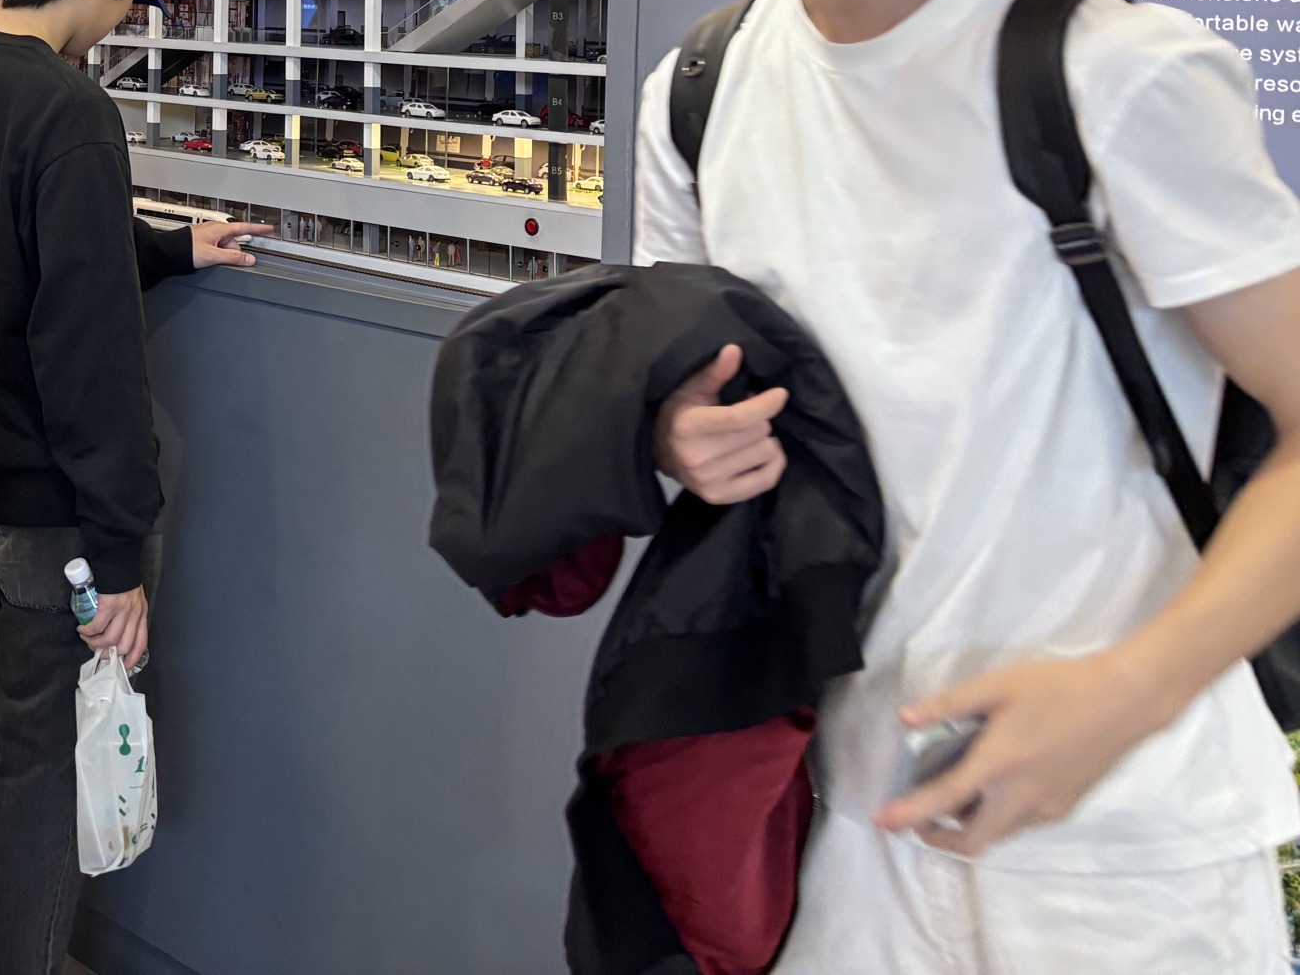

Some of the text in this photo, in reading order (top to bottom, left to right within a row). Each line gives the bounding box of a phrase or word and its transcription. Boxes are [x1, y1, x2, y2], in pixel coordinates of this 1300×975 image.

[553, 12, 564, 20] B3
[552, 98, 563, 106] B4
[551, 167, 562, 175] B5
